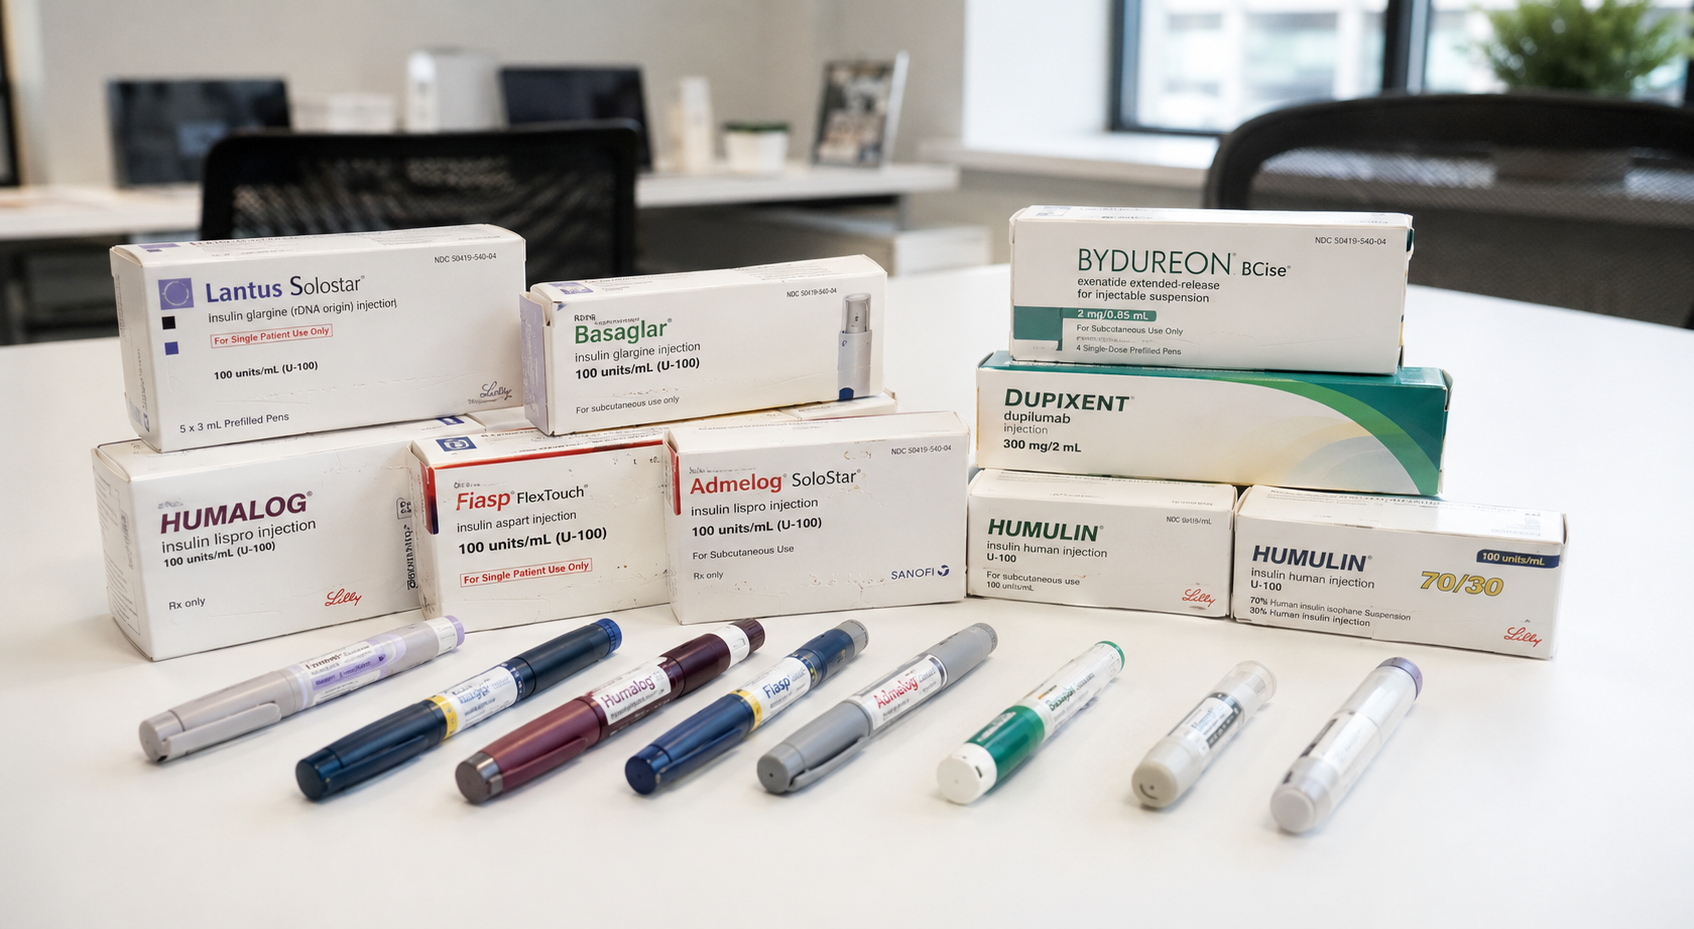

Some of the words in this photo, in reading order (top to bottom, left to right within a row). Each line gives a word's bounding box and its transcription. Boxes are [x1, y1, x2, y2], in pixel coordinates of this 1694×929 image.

[205, 281, 283, 303] Lantus
[1078, 277, 1127, 287] exenatide
[1130, 278, 1219, 290] extended-release
[1078, 289, 1092, 298] for
[1096, 289, 1146, 301] injectable
[1149, 292, 1209, 303] suspension
[208, 311, 243, 323] insulin
[247, 308, 288, 322] glargine
[290, 304, 320, 317] (rDNA
[324, 301, 354, 314] origin)
[1077, 310, 1084, 318] 2
[1133, 312, 1149, 320] mL
[214, 336, 228, 345] For
[231, 333, 258, 345] Single
[260, 330, 290, 341] Patient
[293, 328, 308, 338] Use
[311, 327, 329, 337] Only
[1077, 324, 1089, 332] For
[1148, 327, 1163, 335] Use
[1165, 328, 1183, 336] Only
[576, 351, 609, 362] insulin
[613, 348, 655, 361] glargine
[659, 342, 701, 355] injection
[1083, 345, 1128, 354] Single-Dose
[214, 371, 233, 380] 100
[236, 366, 279, 379] units/mL
[282, 361, 318, 374] (U-100)
[576, 368, 597, 379] 100
[601, 362, 653, 377] units/mL
[657, 357, 700, 373] (U-100)
[576, 406, 589, 414] For
[592, 400, 646, 413] subcutaneous
[648, 398, 662, 406] use
[664, 395, 680, 404] only
[180, 425, 186, 433] 5
[197, 423, 203, 431] 3
[207, 420, 221, 430] mL
[224, 415, 264, 428] Prefilled
[266, 413, 289, 423] Pens
[1004, 411, 1070, 424] dupilumab
[1003, 423, 1048, 435] injection
[1003, 438, 1025, 450] 300
[1029, 441, 1060, 453] mg/2
[1063, 443, 1081, 452] mL
[691, 505, 729, 516] insulin
[734, 502, 766, 515] lispro
[770, 498, 818, 512] injection
[457, 520, 492, 533] insulin
[496, 516, 530, 529] aspart
[533, 510, 577, 525] injection
[692, 525, 714, 537] 100
[719, 521, 773, 535] units/mL
[777, 517, 822, 532] (U-100)
[162, 536, 209, 553] insulin
[215, 530, 253, 545] lispro
[258, 519, 316, 539] injection
[459, 541, 484, 554] 100
[489, 534, 551, 551] units/mL
[556, 527, 607, 546] (U-100)
[164, 557, 183, 567] 100
[187, 548, 234, 564] units/mL
[237, 541, 276, 557] (U-100)
[692, 552, 707, 560] For
[710, 547, 774, 559] Subcutaneous
[777, 545, 794, 553] Use
[987, 541, 1020, 551] insulin
[1024, 543, 1059, 554] human
[1063, 546, 1107, 558] injection
[987, 553, 1017, 563] U-100
[1482, 552, 1500, 562] 100
[1502, 555, 1545, 566] units/mL
[464, 575, 479, 584] For
[482, 571, 510, 583] Single
[513, 567, 546, 578] Patient
[548, 565, 565, 574] Use
[568, 562, 589, 573] Only
[693, 572, 704, 580] Rx
[706, 571, 723, 580] only
[891, 567, 935, 580] SANOFI
[987, 571, 1000, 579] For
[1003, 573, 1062, 584] subcutaneous
[1251, 567, 1286, 579] insulin
[1289, 571, 1325, 584] human
[1329, 575, 1375, 589] injection
[987, 581, 1000, 589] 100
[1251, 580, 1282, 591] U-100
[1420, 571, 1504, 596] 70/30
[169, 601, 182, 610] Rx
[185, 597, 205, 608] only
[324, 588, 363, 606] Lilly
[1182, 588, 1216, 607] Lilly
[1250, 596, 1268, 605] 70%
[1270, 599, 1298, 609] Human
[1300, 601, 1325, 612] insulin
[1250, 606, 1267, 615] 30%
[1270, 609, 1300, 619] Human
[1302, 612, 1330, 622] insulin
[1333, 615, 1370, 627] injection
[1504, 627, 1542, 647] Lilly
